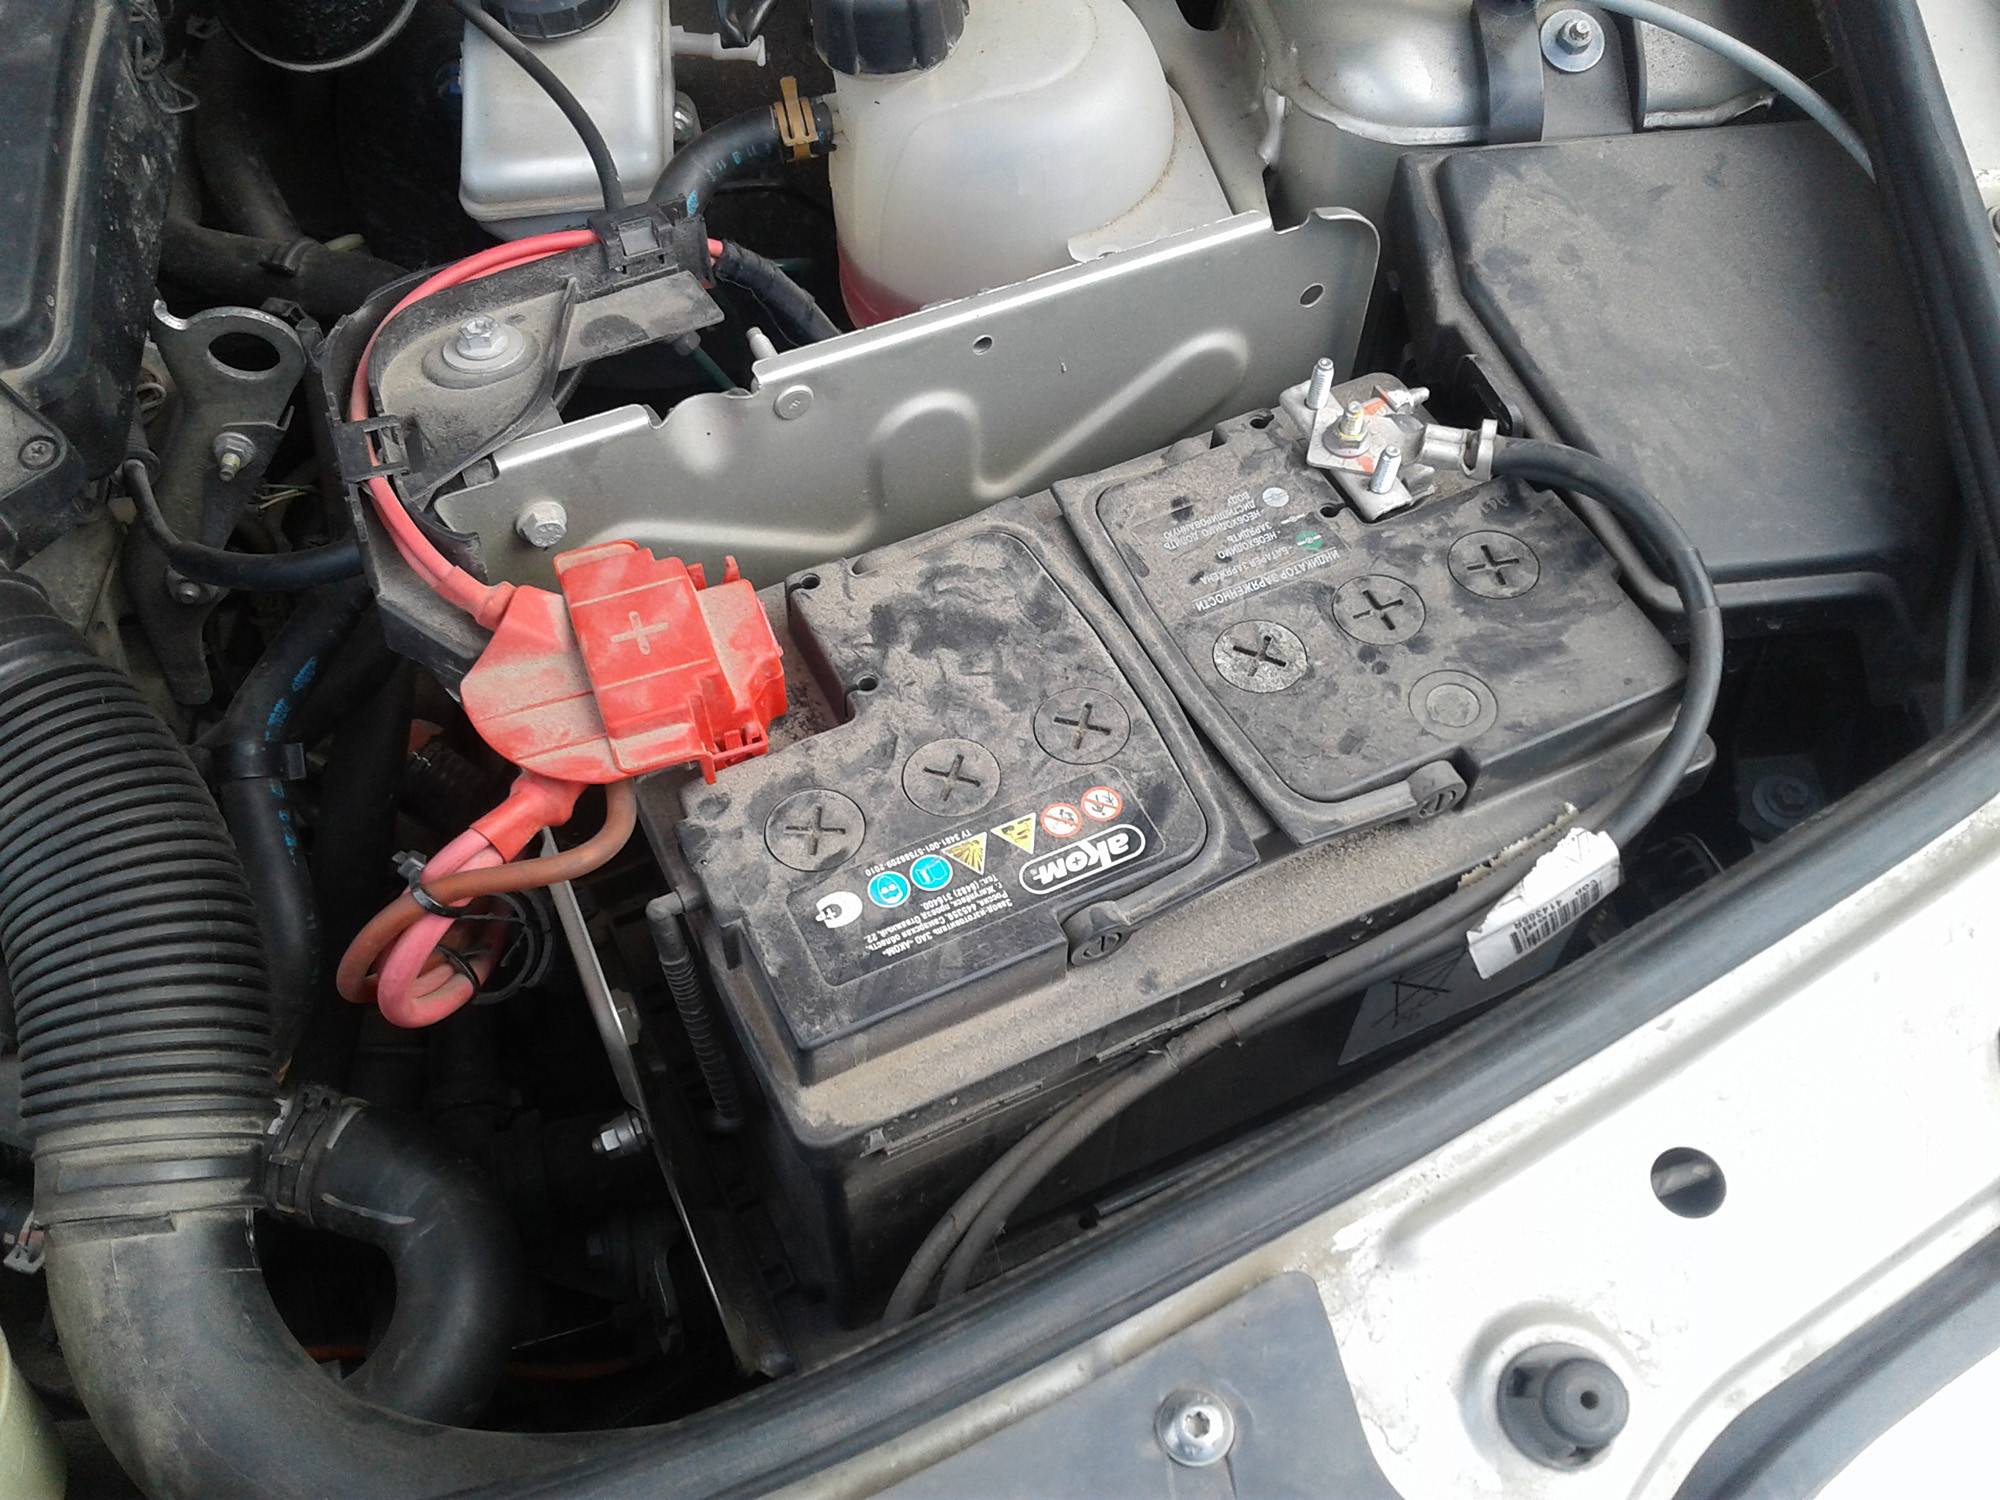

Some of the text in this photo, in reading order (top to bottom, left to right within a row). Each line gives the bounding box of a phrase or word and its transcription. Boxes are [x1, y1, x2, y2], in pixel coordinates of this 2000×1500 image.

[1223, 490, 1251, 506] ВОДУ
[1225, 520, 1273, 544] ЗАРЯДИТЬ
[1193, 548, 1340, 612] ИНДИКАТОР ЗАРЯЖЕННОСТИ
[958, 828, 972, 838] ТУ
[975, 889, 1008, 908] Россия,
[919, 901, 950, 919] проезд
[931, 897, 1013, 936] Завод-изготовитель
[900, 914, 946, 938] Самарская
[913, 930, 932, 944] ЗАО
